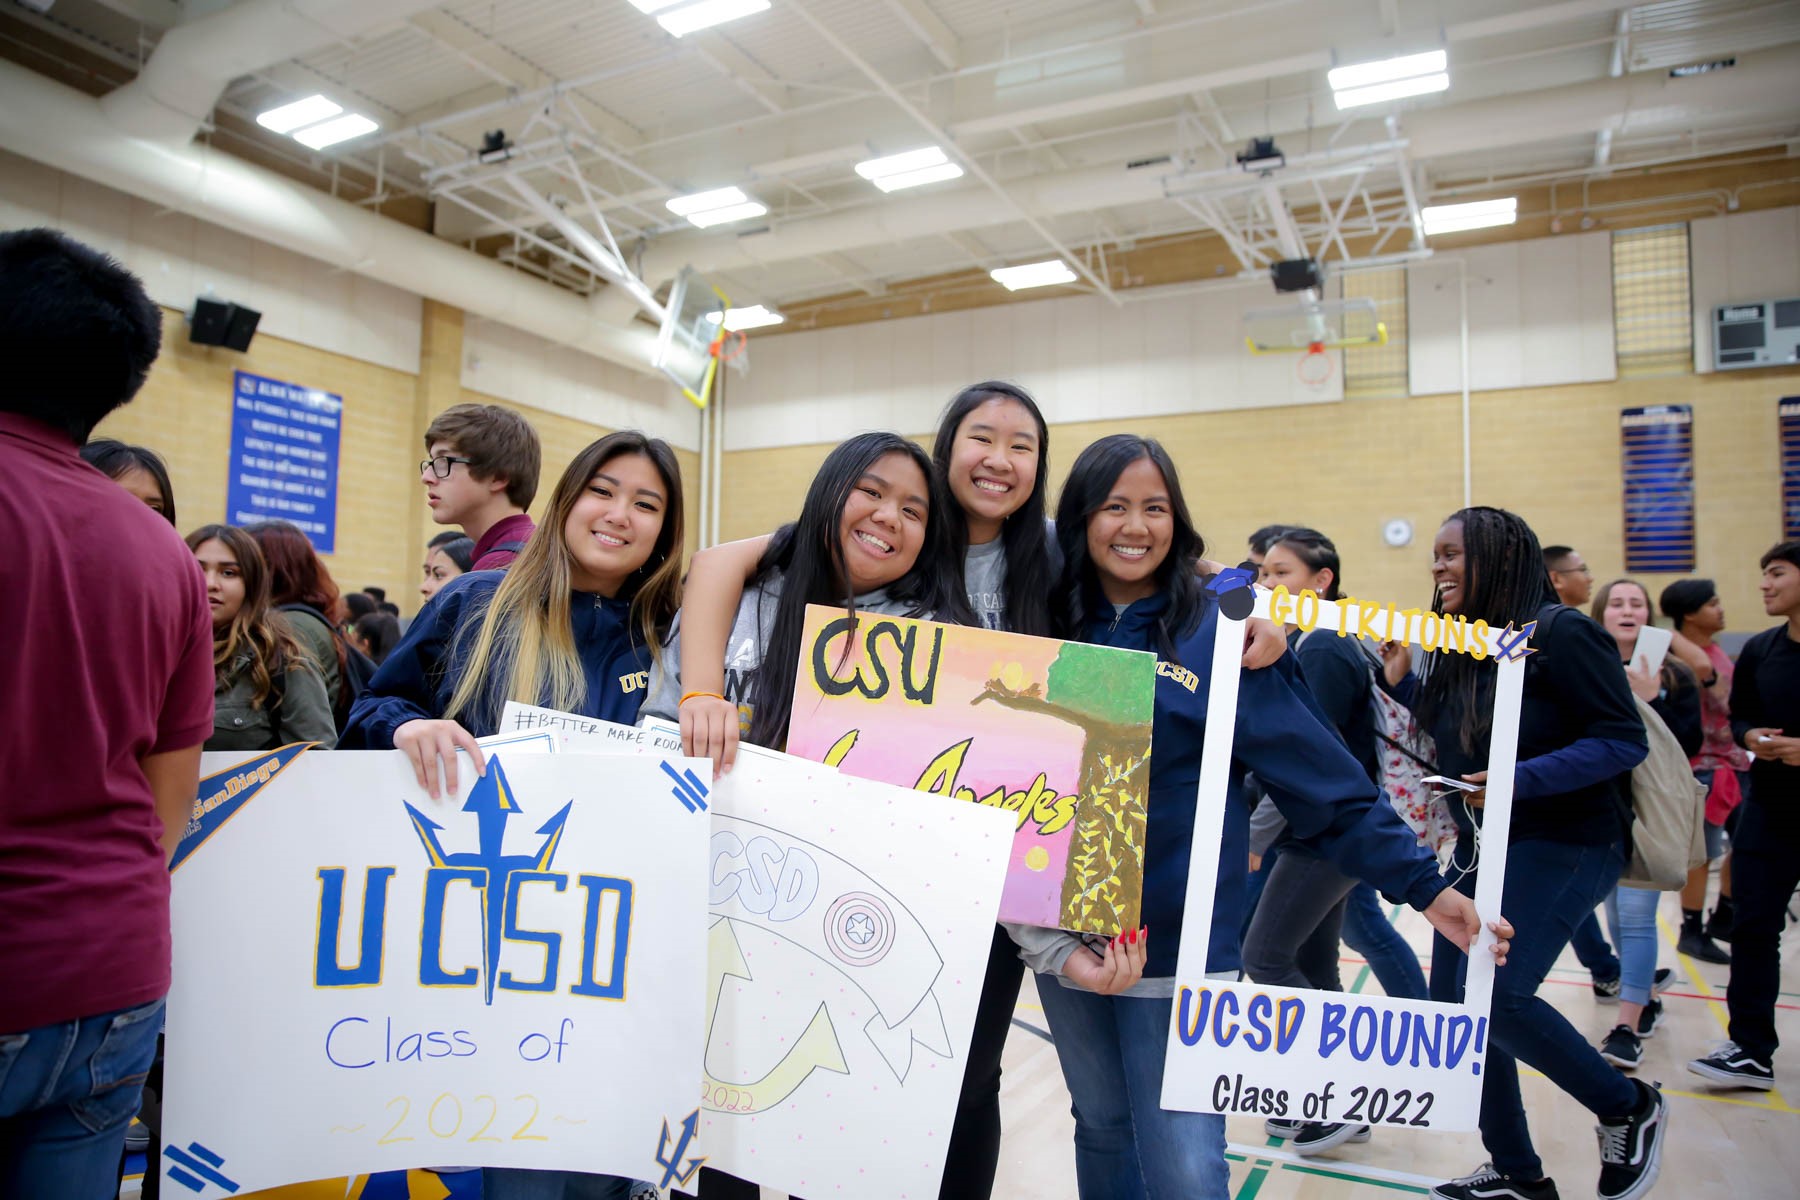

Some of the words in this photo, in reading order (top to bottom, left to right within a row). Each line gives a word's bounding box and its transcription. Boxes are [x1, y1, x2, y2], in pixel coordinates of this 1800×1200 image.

[1268, 584, 1320, 633] GO
[1335, 595, 1490, 661] TRITONS
[812, 616, 944, 705] CSU
[1155, 661, 1200, 694] CSD
[514, 709, 600, 735] #BETTER
[607, 727, 647, 745] MAKE
[312, 865, 636, 1001] UCSD
[325, 1016, 478, 1069] Class
[518, 1018, 575, 1064] of
[1175, 983, 1306, 1056] UCSD
[1317, 1003, 1488, 1077] BOUND!
[702, 1081, 756, 1112] 2022
[1212, 1073, 1289, 1117] Class
[1302, 1080, 1335, 1121] of
[1341, 1085, 1435, 1128] 2022
